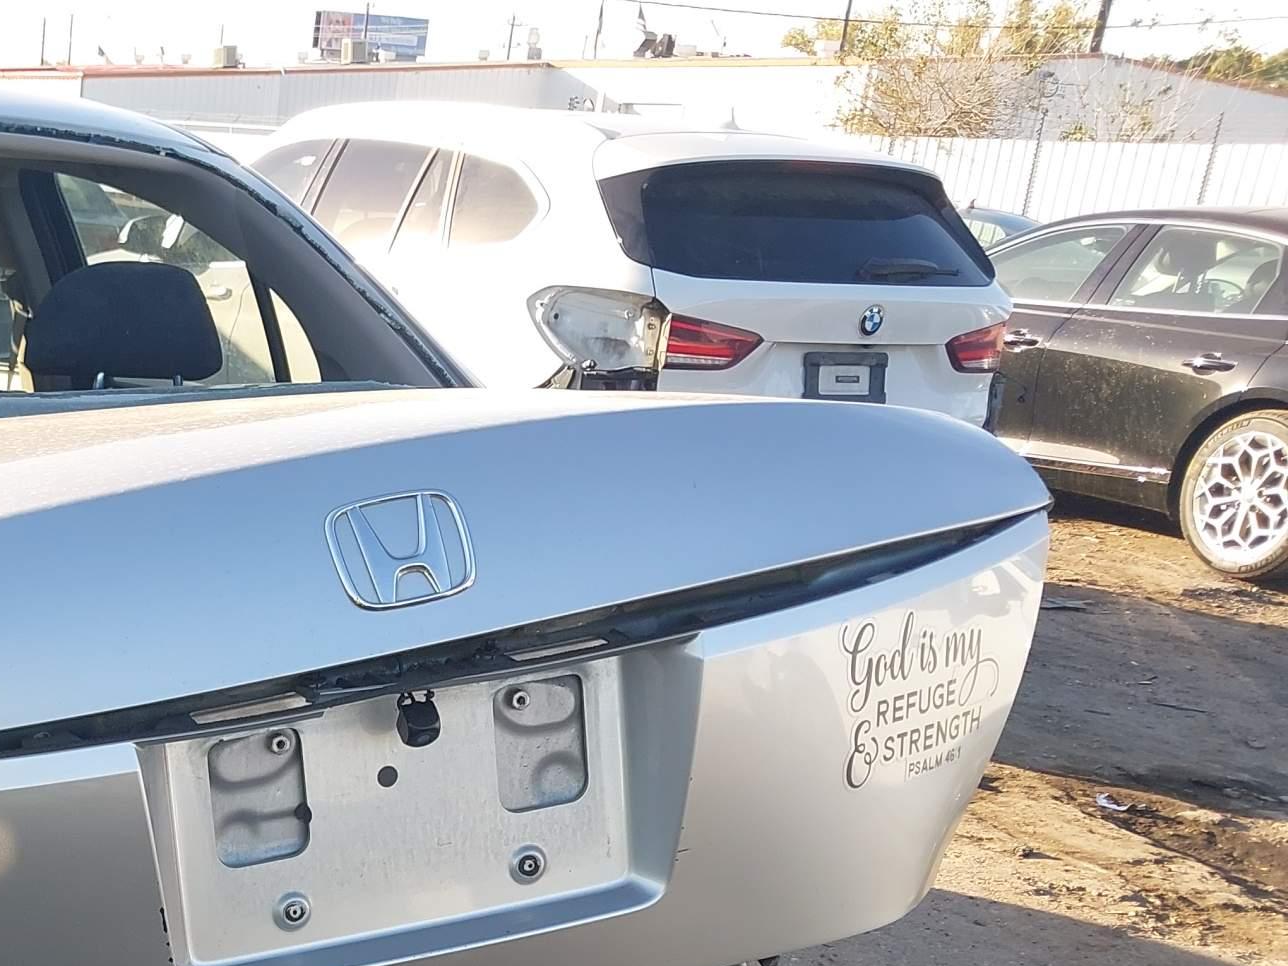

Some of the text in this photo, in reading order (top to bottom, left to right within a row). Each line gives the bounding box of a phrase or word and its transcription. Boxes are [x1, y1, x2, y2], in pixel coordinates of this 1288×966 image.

[842, 611, 1000, 713] God is my
[876, 678, 957, 727] REFUGE
[882, 705, 983, 762] STRENGTH
[908, 751, 943, 777] PSALM
